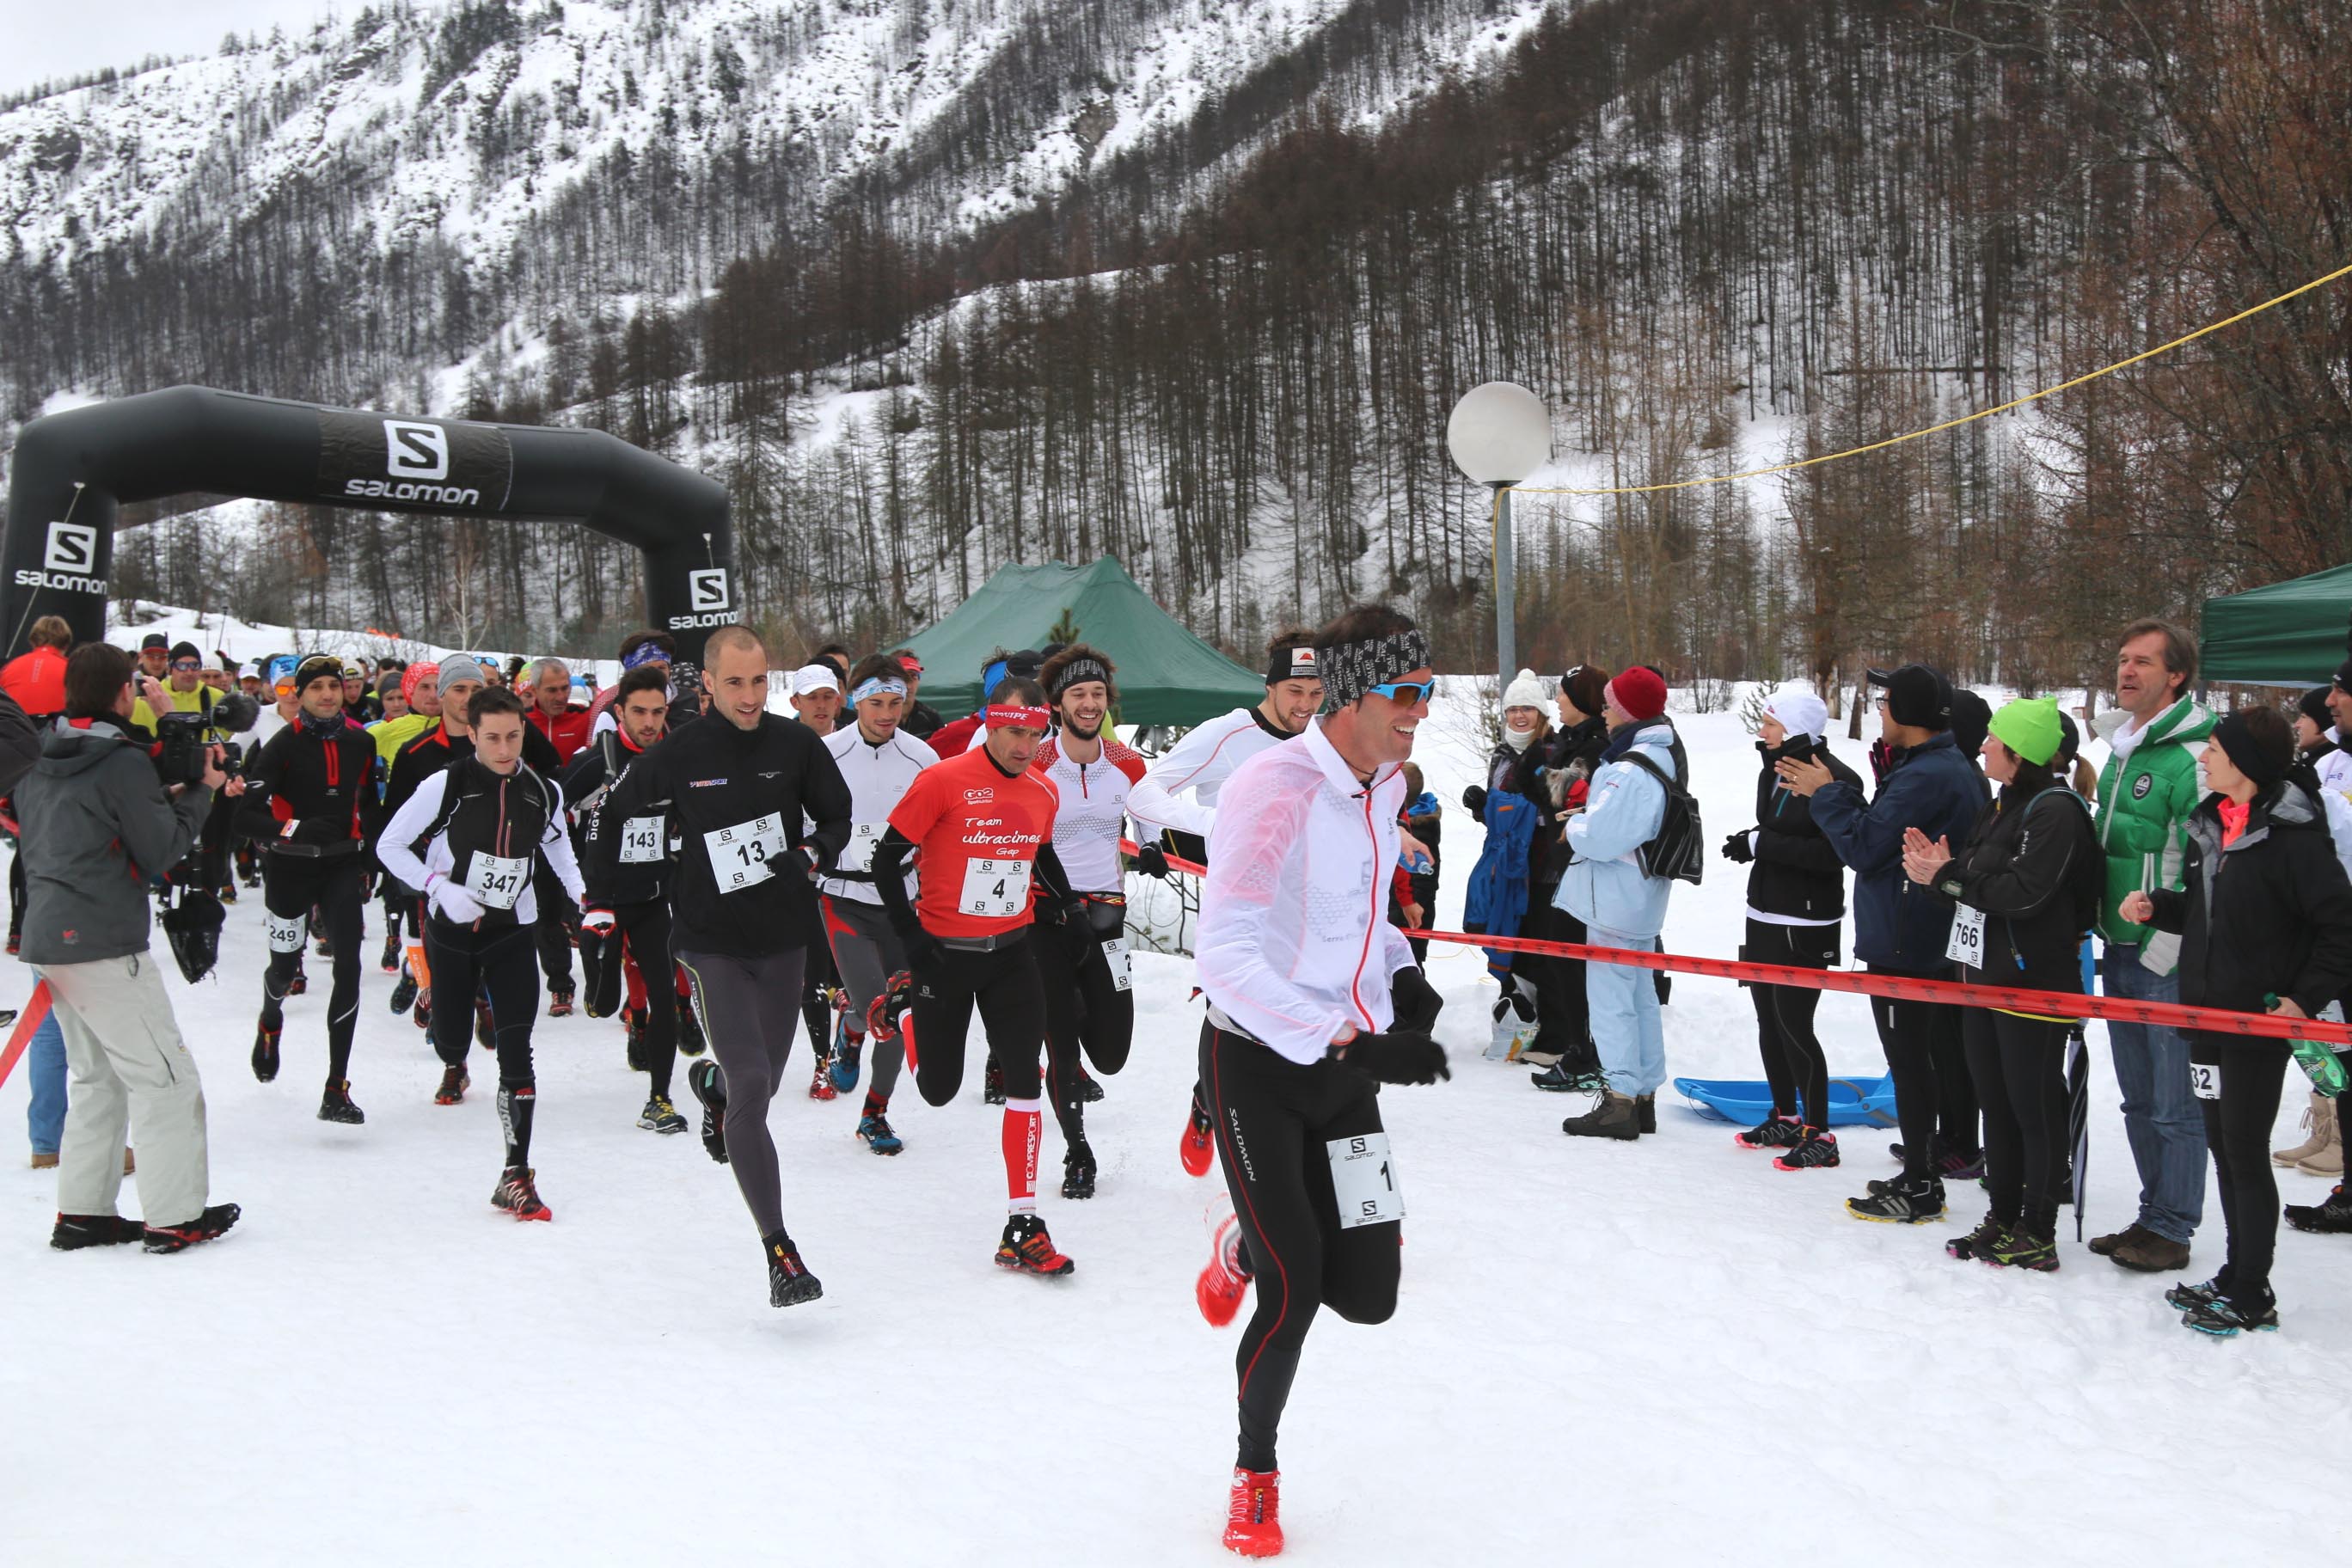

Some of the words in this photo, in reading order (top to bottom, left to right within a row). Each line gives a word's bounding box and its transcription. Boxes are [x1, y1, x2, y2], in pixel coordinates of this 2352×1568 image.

[669, 610, 738, 629] salomo
[590, 811, 601, 840] DIGN
[965, 818, 1002, 827] Team
[627, 831, 655, 848] 143
[962, 830, 1042, 844] ultracimes
[737, 840, 765, 867] 13
[995, 847, 1020, 857] Gap
[482, 872, 517, 893] 347
[992, 879, 1005, 899] 4
[269, 925, 297, 942] 249
[1956, 922, 1979, 948] 766
[1229, 1108, 1256, 1182] SALOMON
[1380, 1161, 1393, 1191] 1
